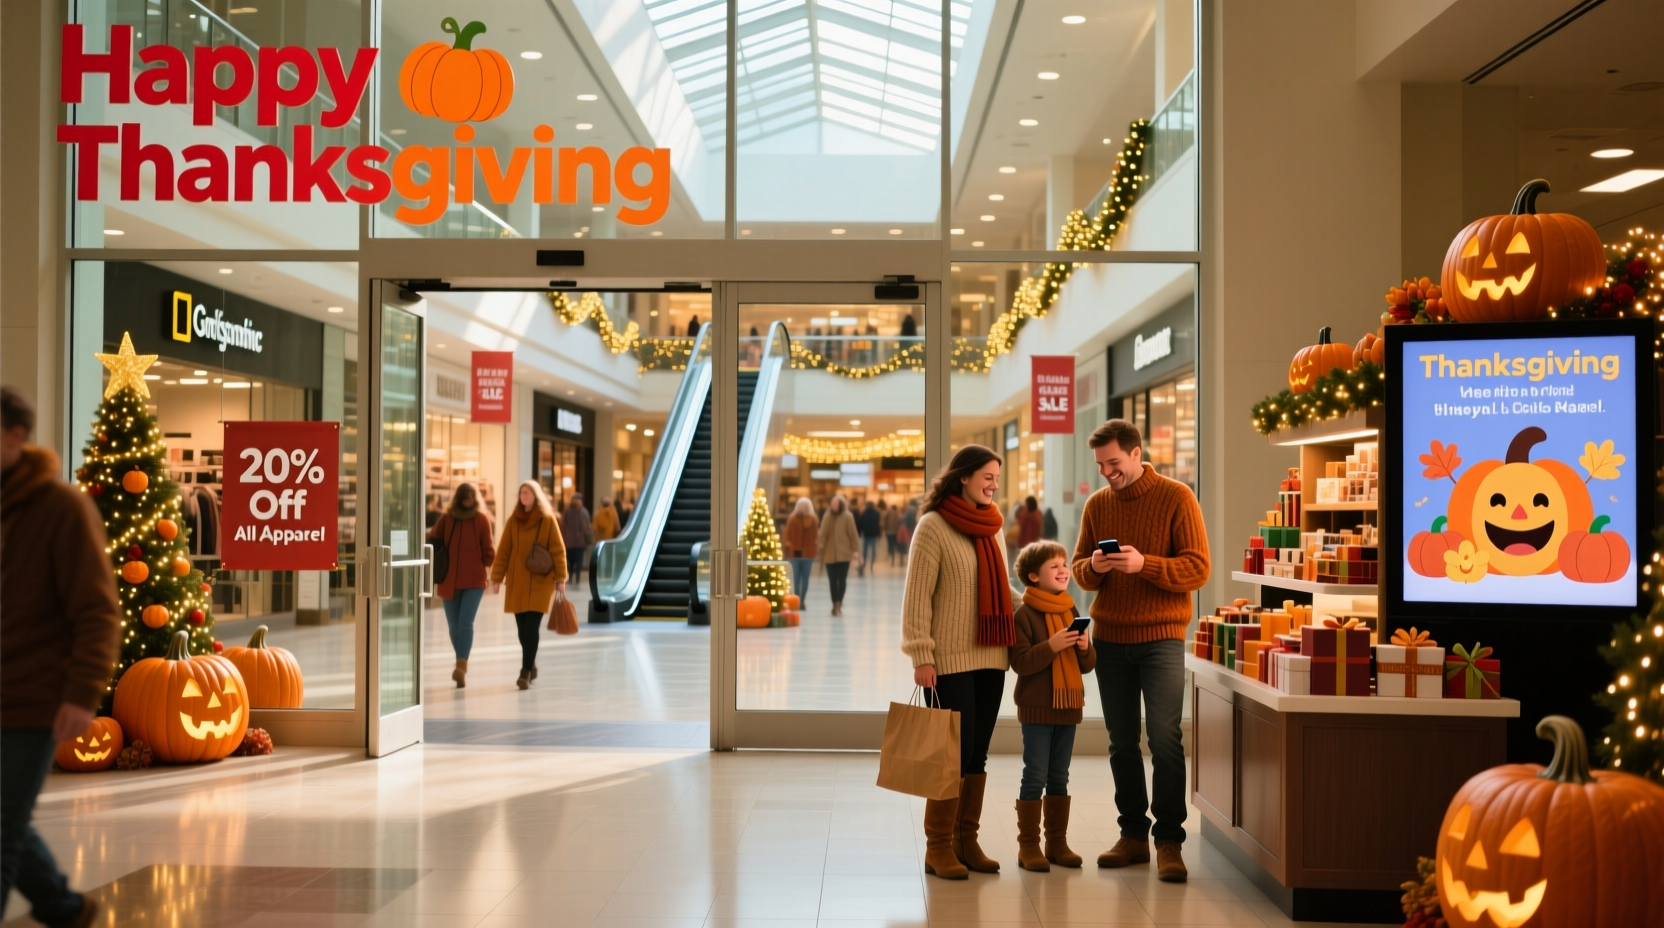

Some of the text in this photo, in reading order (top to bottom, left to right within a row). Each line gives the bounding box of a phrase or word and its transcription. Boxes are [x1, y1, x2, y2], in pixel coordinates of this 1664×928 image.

[60, 24, 379, 128] Happy
[56, 123, 672, 226] Thanksgiving
[1419, 350, 1620, 381] Thanksgiving
[239, 447, 325, 484] 20%
[249, 489, 308, 520] Off
[234, 525, 326, 546] All Apparel
